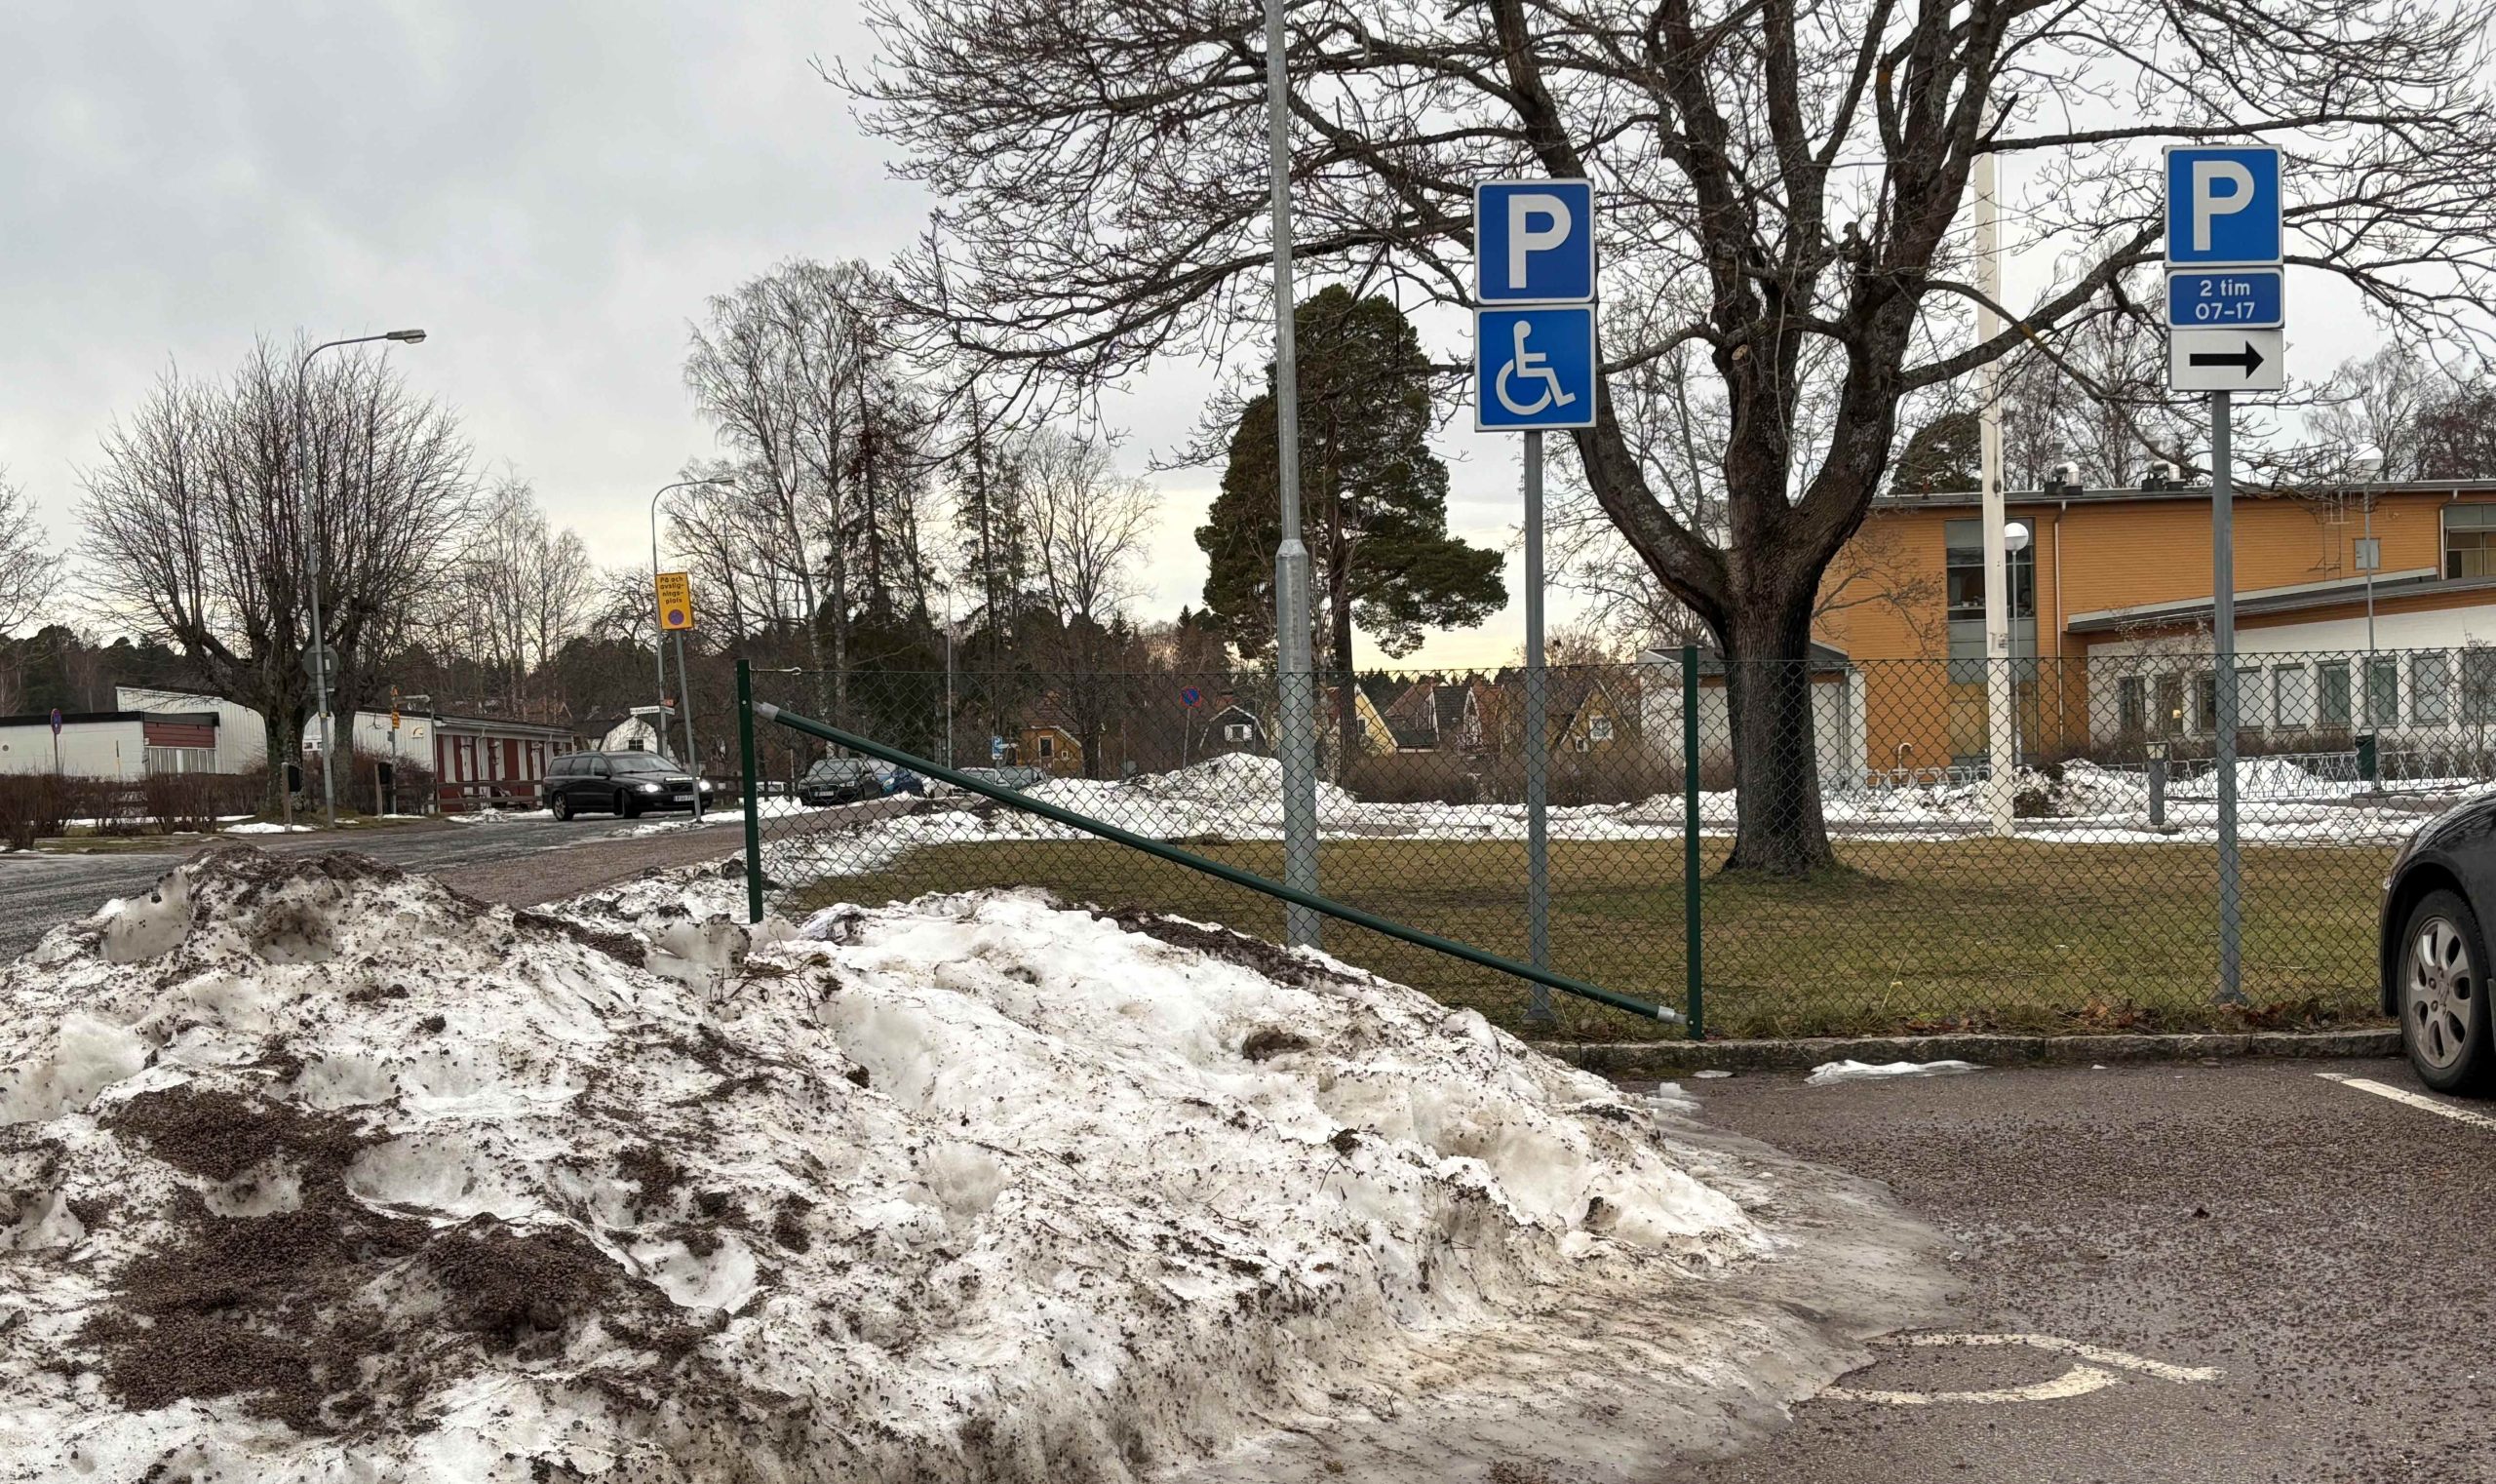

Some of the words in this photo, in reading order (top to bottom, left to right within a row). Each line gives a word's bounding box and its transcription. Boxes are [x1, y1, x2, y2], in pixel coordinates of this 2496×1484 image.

[2193, 160, 2255, 252] P
[1508, 194, 1572, 289] P
[2195, 302, 2255, 320] 07-17
[2200, 280, 2211, 296] 2
[2220, 279, 2250, 296] tim
